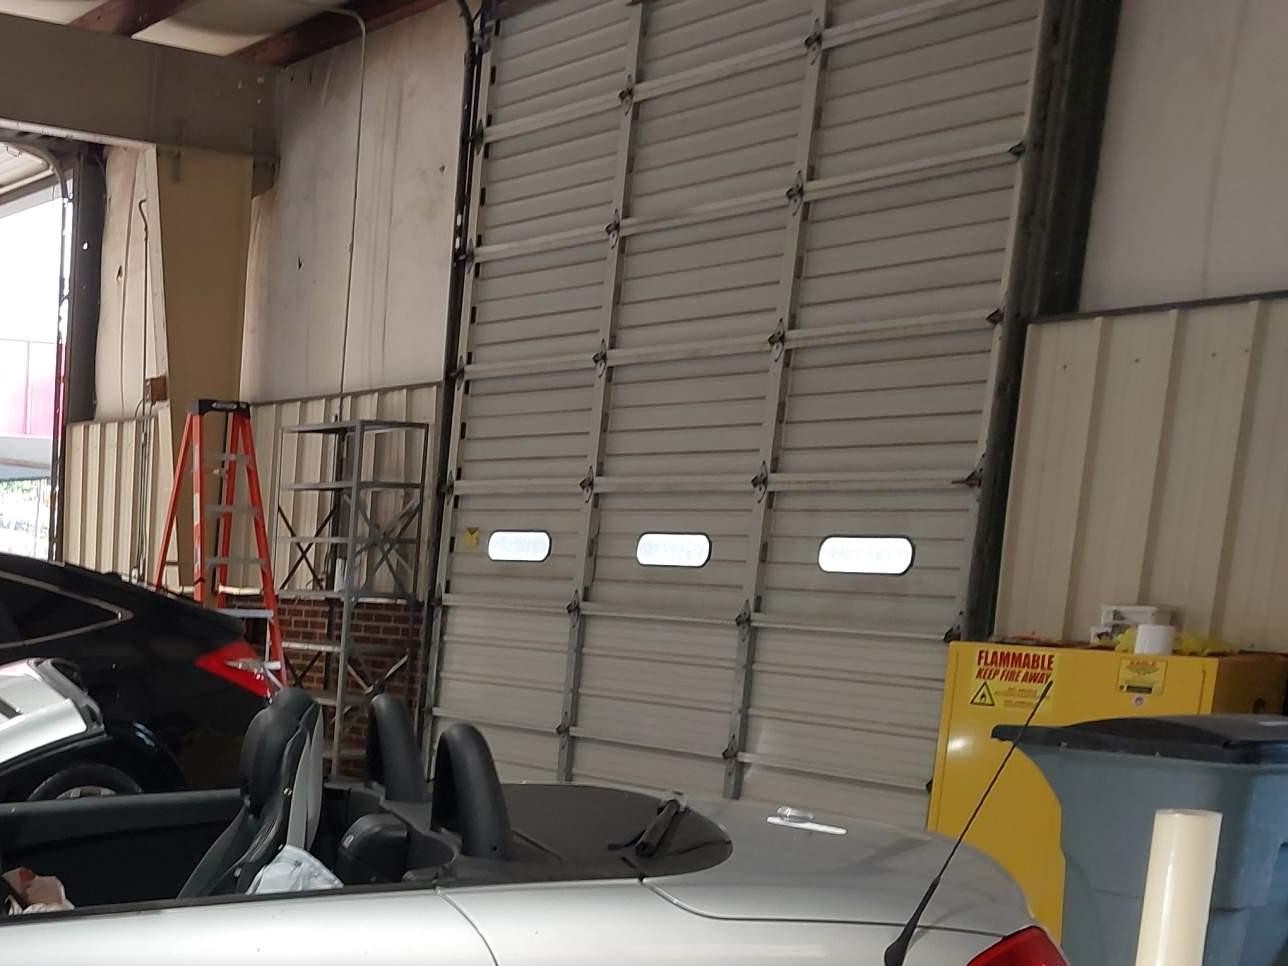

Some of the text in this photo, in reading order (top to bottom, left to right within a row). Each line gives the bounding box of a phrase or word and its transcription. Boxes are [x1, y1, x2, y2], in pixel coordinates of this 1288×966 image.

[977, 650, 1055, 671] FLAMMABLE
[976, 667, 1001, 680] KEEP
[1021, 671, 1052, 684] AWAY
